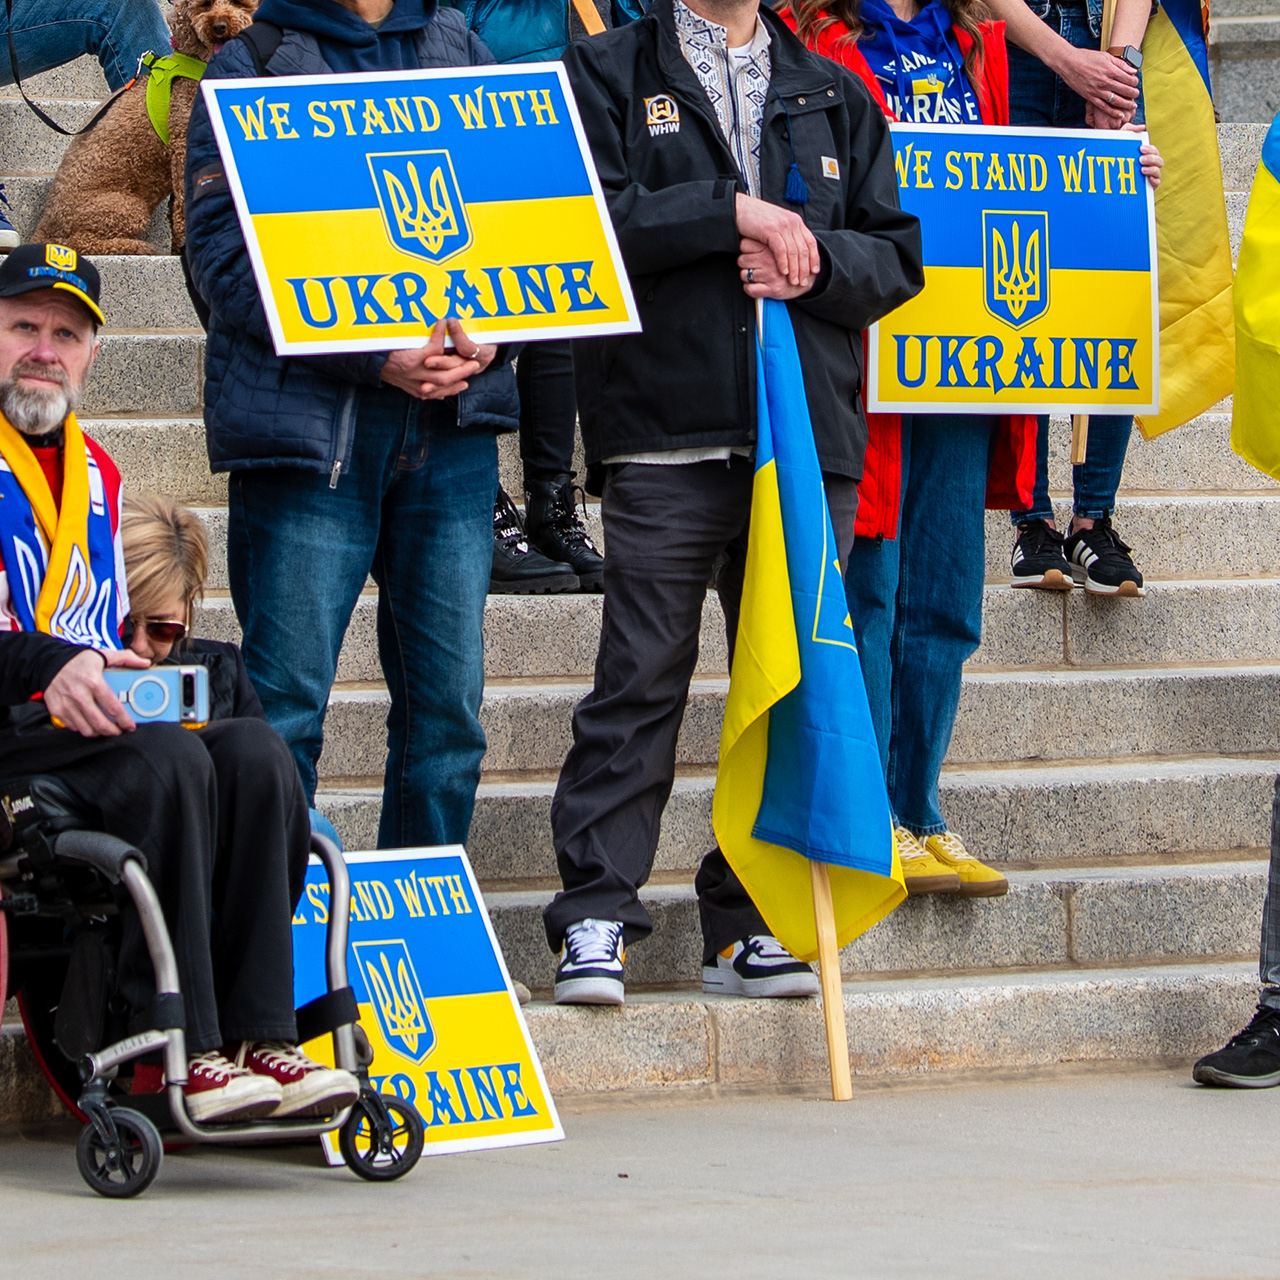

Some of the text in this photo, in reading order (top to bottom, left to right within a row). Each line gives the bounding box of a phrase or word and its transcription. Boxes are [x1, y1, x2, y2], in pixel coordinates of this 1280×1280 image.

[230, 84, 560, 142] WE STAND WITH
[648, 122, 680, 138] WHW
[895, 142, 1138, 195] WE STAND WITH
[284, 260, 611, 329] UKRAINE
[891, 334, 1140, 396] UKRAINE
[394, 869, 472, 918] WITH
